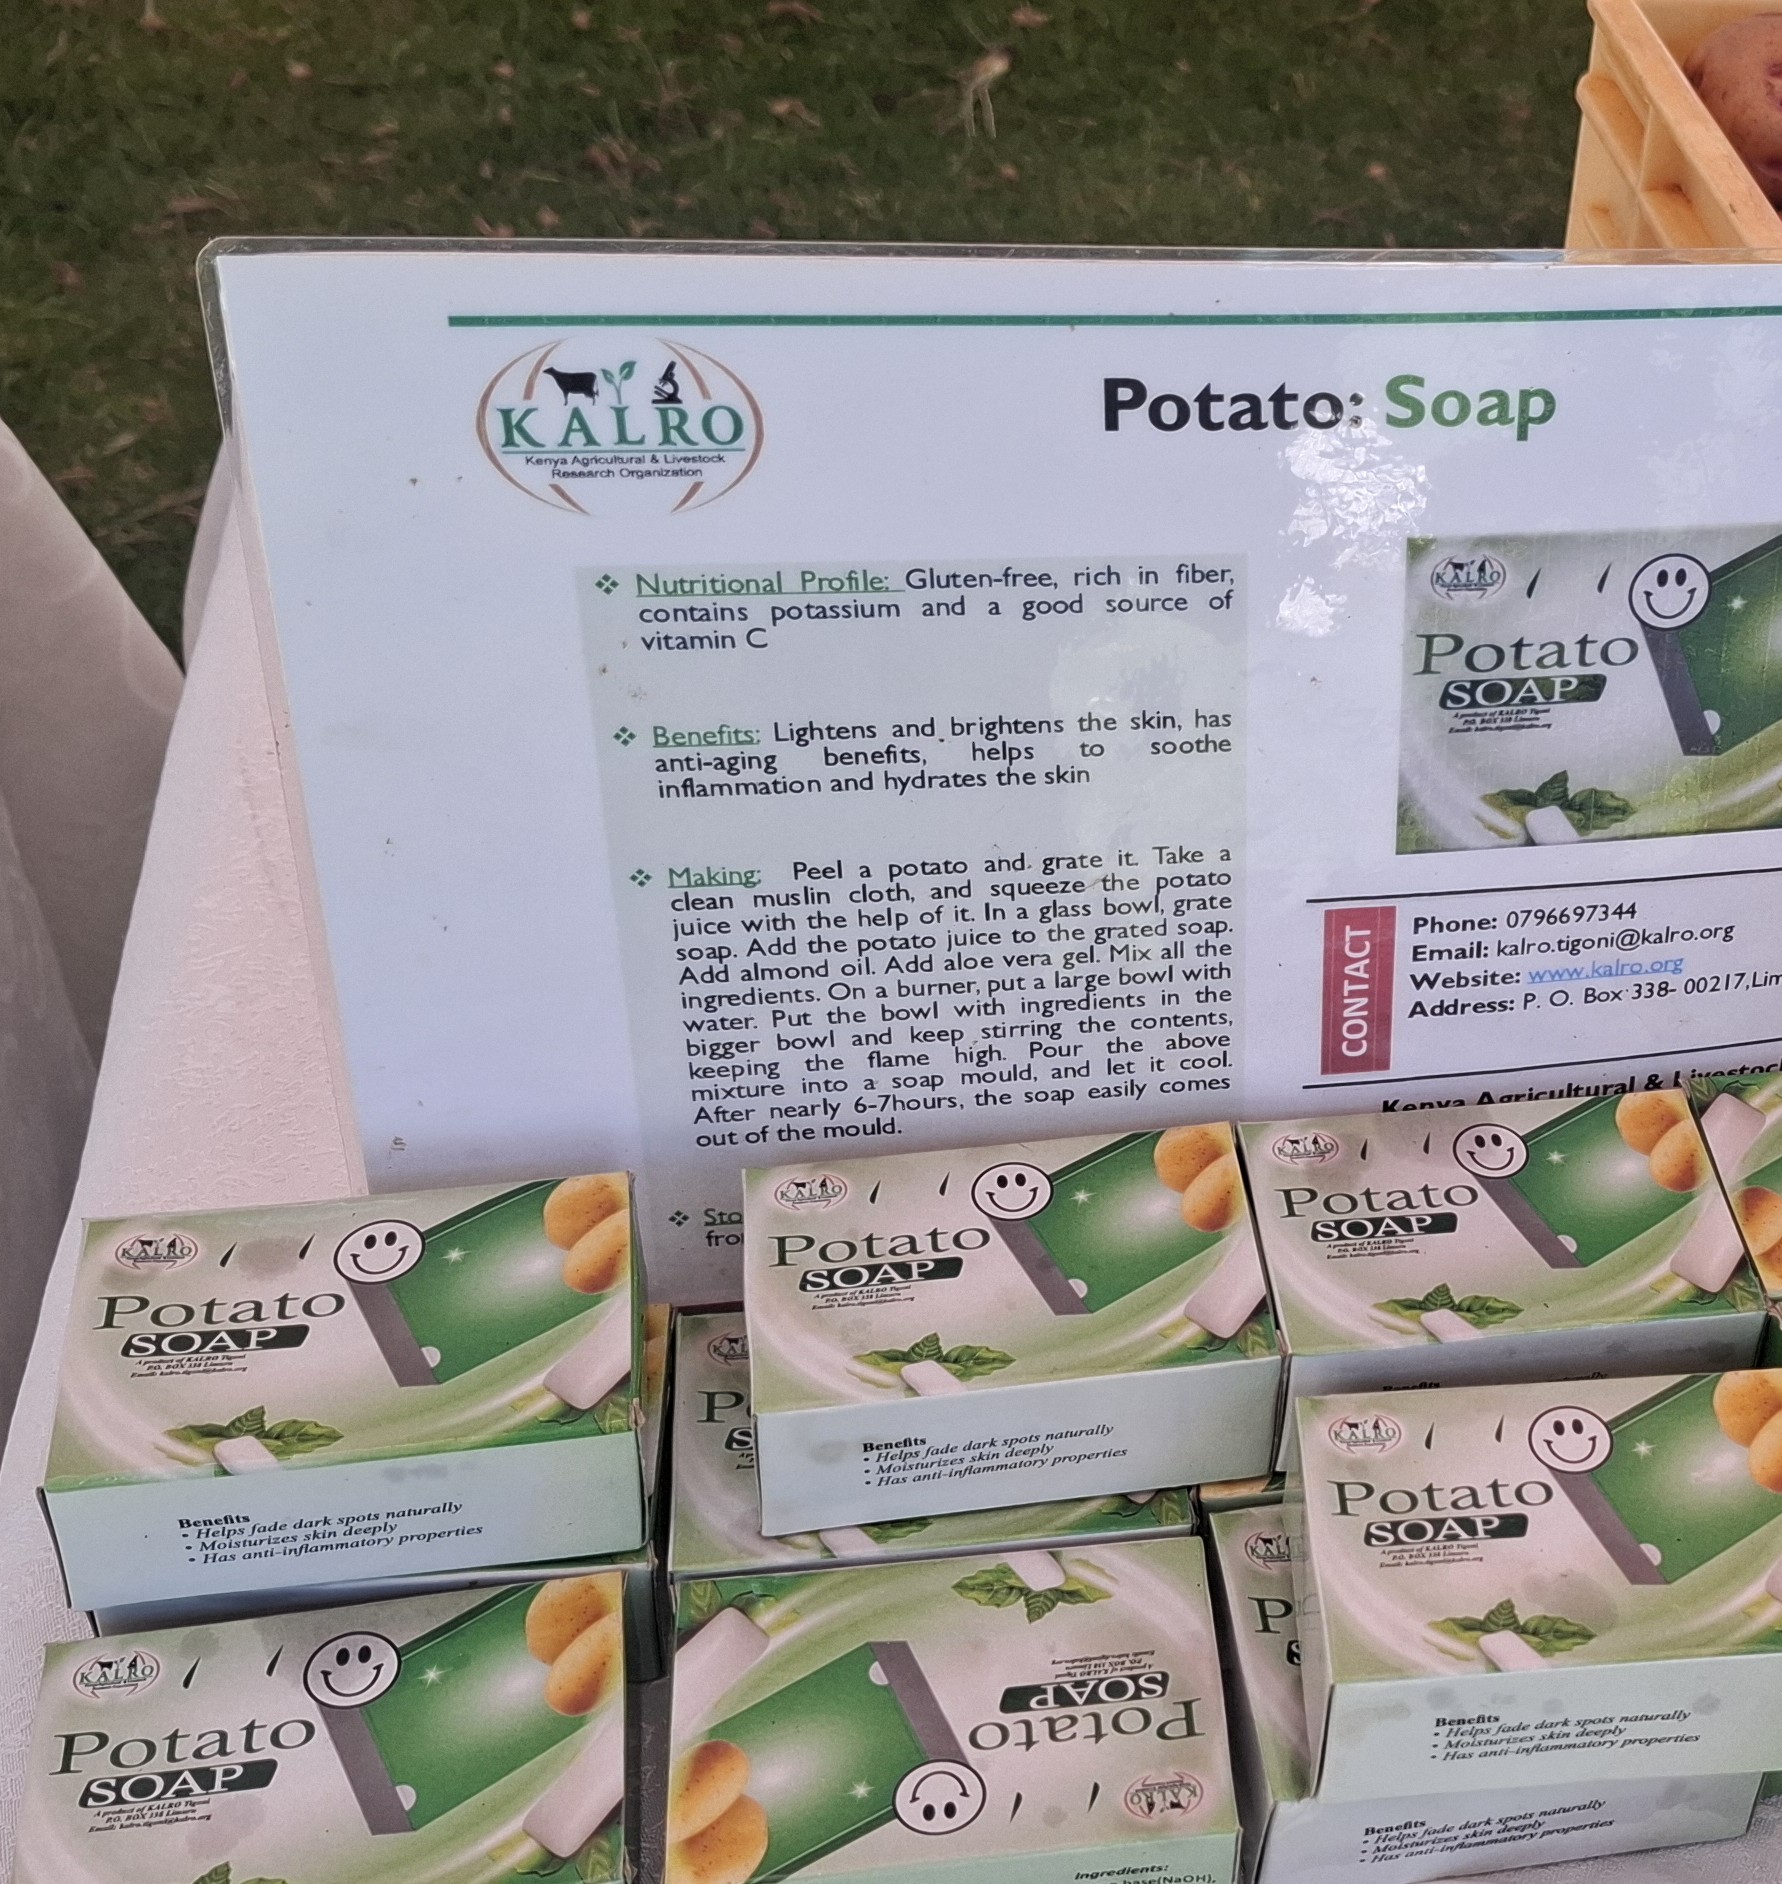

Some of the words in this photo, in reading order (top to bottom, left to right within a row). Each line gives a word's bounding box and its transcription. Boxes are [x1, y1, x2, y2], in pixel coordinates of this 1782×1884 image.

[1104, 377, 1364, 432] Potato:
[1385, 374, 1557, 441] Soap
[497, 405, 744, 448] KALRO
[525, 455, 570, 468] Kenya
[572, 455, 646, 466] Agricultural
[650, 454, 659, 464] &
[664, 453, 725, 464] Livestock
[552, 469, 615, 479] Research
[619, 468, 702, 479] Organization
[636, 570, 783, 597] Nutritional
[800, 569, 891, 594] Profile:
[905, 566, 1058, 590] Gluten-free,
[1074, 565, 1121, 586] rich
[1139, 566, 1159, 585] in
[1176, 562, 1234, 586] fiber,
[1435, 568, 1501, 586] KALRO
[639, 602, 748, 623] contains
[771, 599, 900, 627] potassium
[922, 595, 965, 617] and
[988, 601, 1001, 615] a
[1022, 593, 1083, 621] good
[1106, 597, 1188, 613] source
[1209, 589, 1234, 610] of
[641, 630, 736, 650] vitamin
[746, 627, 768, 648] C
[1412, 633, 1639, 676] Potato
[1446, 677, 1580, 707] SOAP
[653, 724, 760, 748] Benefits:
[774, 721, 877, 747] Lightens
[892, 717, 936, 738] and
[951, 715, 1064, 741] brightens
[1078, 712, 1117, 732] the
[1131, 710, 1182, 731] skin,
[1195, 709, 1231, 728] has
[655, 751, 777, 776] anti-aging
[824, 744, 926, 766] benefits,
[972, 740, 1034, 765] helps
[1080, 742, 1104, 757] to
[1151, 734, 1231, 755] soothe
[658, 776, 821, 798] inflammation
[830, 771, 873, 792] and
[884, 769, 987, 796] hydrates
[996, 767, 1036, 786] the
[1045, 765, 1090, 784] skin
[669, 867, 761, 888] Making:
[793, 860, 843, 880] Peel
[859, 865, 872, 878] a
[889, 860, 968, 883] potato
[984, 852, 1025, 872] and
[1042, 855, 1103, 876] grate
[1118, 850, 1138, 866] it.
[1152, 845, 1204, 864] Take
[1220, 849, 1231, 861] a
[671, 891, 733, 912] clean
[753, 886, 830, 908] muslin
[849, 882, 915, 903] cloth,
[930, 879, 971, 900] and
[990, 881, 1086, 901] squeeze
[1103, 872, 1140, 892] the
[1156, 871, 1232, 895] potato
[1413, 916, 1497, 935] Phone:
[1506, 902, 1637, 928] 0796697344
[1412, 941, 1489, 962] Email:
[1497, 925, 1735, 957] kalro.tigoni@kalro.org
[1342, 925, 1371, 1057] CONTACT
[1409, 968, 1521, 991] Website:
[1527, 958, 1684, 984] www.kalro.org
[1408, 998, 1515, 1018] Address:
[1523, 993, 1540, 1010] P.
[1549, 990, 1573, 1007] O.
[1584, 984, 1624, 1004] Box
[1630, 981, 1677, 1001] 338-
[1643, 1073, 1663, 1091] &
[696, 1131, 739, 1147] out
[745, 1125, 769, 1144] of
[777, 1123, 815, 1142] the
[823, 1117, 902, 1138] mould.
[1274, 1184, 1478, 1218] Potato
[1315, 1215, 1432, 1241] SOAP
[768, 1226, 991, 1268] Potato
[804, 1260, 936, 1292] SOAP
[92, 1292, 345, 1330] Potato
[129, 1328, 277, 1357] SOAP
[1327, 1478, 1554, 1517] Potato
[178, 1514, 250, 1529] Benefits
[196, 1526, 245, 1540] Helps
[248, 1521, 288, 1537] fade
[292, 1516, 332, 1530] dark
[336, 1513, 380, 1527] spots
[386, 1501, 462, 1519] naturally
[199, 1535, 298, 1552] Moisturizes
[303, 1529, 337, 1542] skin
[342, 1521, 398, 1537] deeply
[1369, 1517, 1501, 1546] SOAP
[203, 1552, 236, 1564] Has
[242, 1536, 394, 1560] anti-inflammatory
[398, 1526, 483, 1546] properties
[1030, 1673, 1163, 1709] SOAP
[968, 1698, 1206, 1752] Potato
[49, 1718, 316, 1776] Potato
[87, 1764, 244, 1807] SOAP
[1075, 1865, 1169, 1881] Ingredients:
